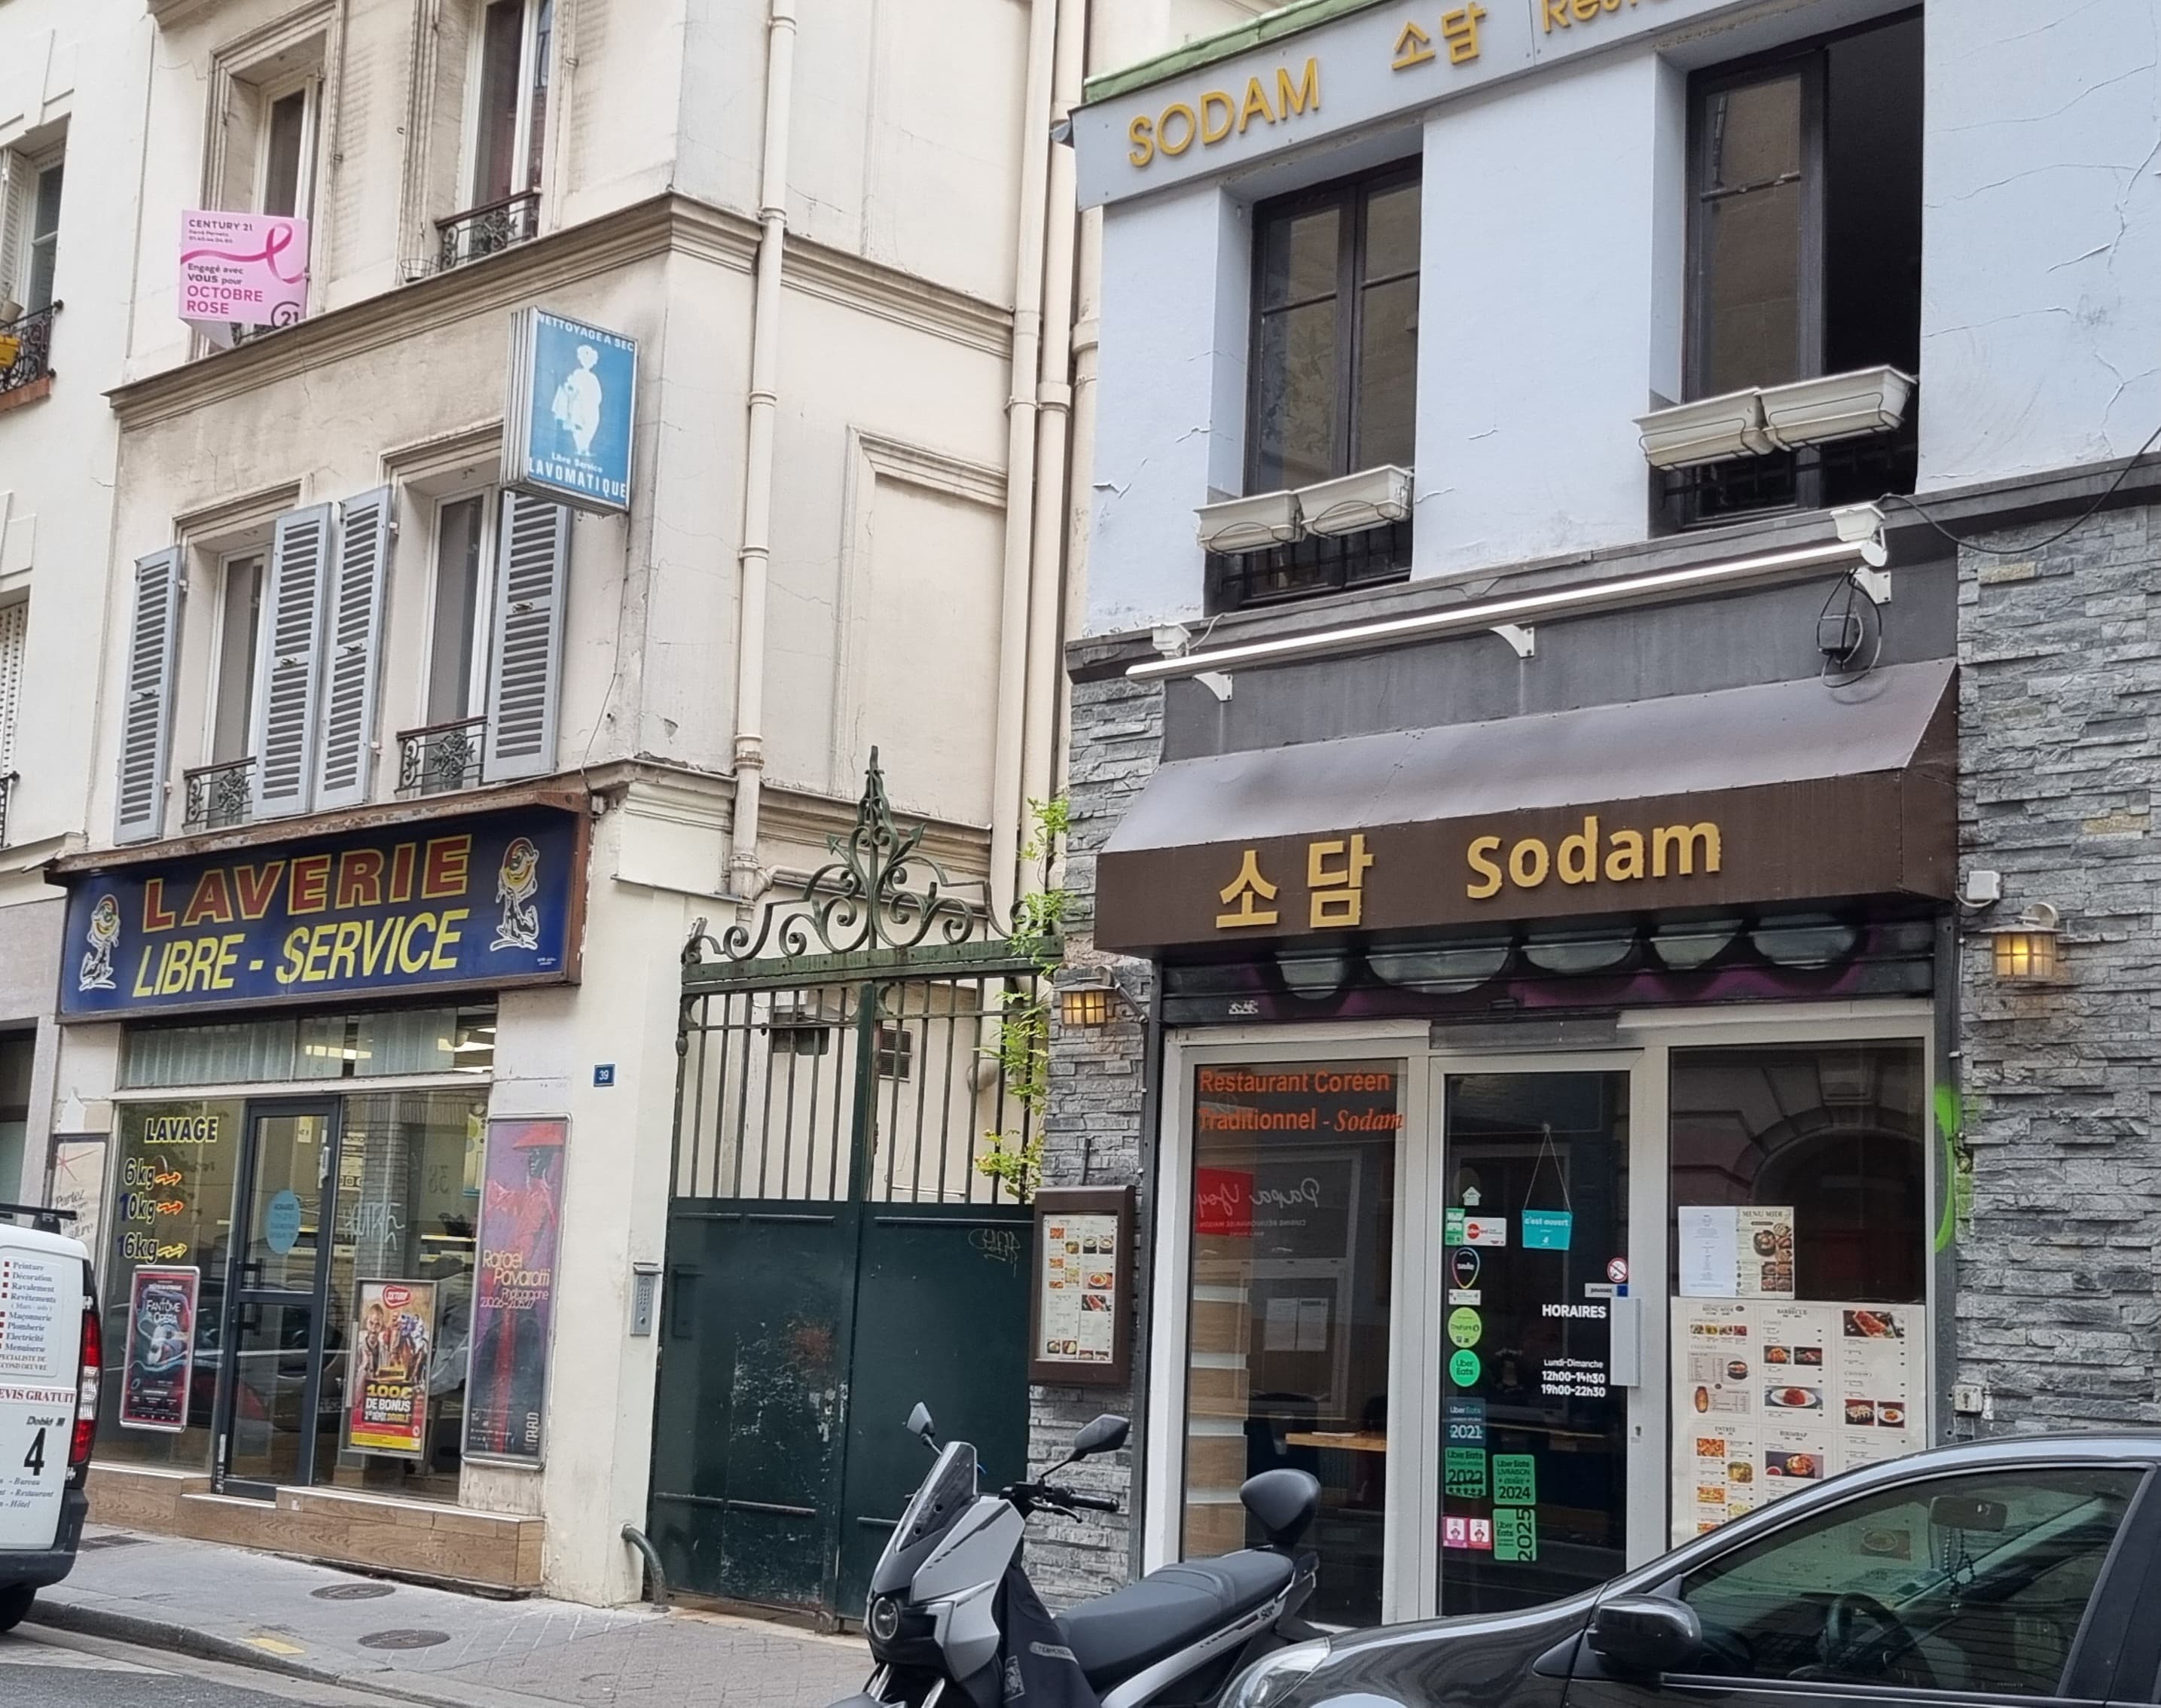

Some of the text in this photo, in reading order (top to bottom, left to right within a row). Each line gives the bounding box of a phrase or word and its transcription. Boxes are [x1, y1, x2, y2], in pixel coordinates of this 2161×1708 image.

[1392, 2, 1488, 70] 소담
[1127, 57, 1320, 167] SODAM
[189, 219, 253, 231] CENTURY 21
[188, 264, 220, 273] Engagé
[188, 285, 264, 303] OCTOBRE
[187, 300, 229, 314] ROSE
[280, 311, 299, 325] 21
[538, 314, 602, 342] NETTOYAGE
[615, 337, 635, 352] SEC
[529, 458, 626, 498] LAVOMATIQUE
[1467, 816, 1721, 899] Sodam
[142, 834, 472, 933] LAVERIE
[133, 934, 248, 997] LIBRE
[276, 908, 470, 984] SERVICE
[599, 1070, 609, 1081] 39
[1200, 1069, 1390, 1093] Restaurant Coréen
[1198, 1108, 1316, 1130] Traditionnel
[1334, 1109, 1405, 1131] Sodam
[145, 1116, 218, 1143] LAVAGE
[124, 1157, 156, 1191] 6kg
[119, 1192, 157, 1224] 10kg
[1544, 1218, 1569, 1227] ouvert
[118, 1232, 159, 1264] 16kg
[483, 1249, 523, 1268] Rafael
[12, 1282, 54, 1292] Ravalement
[1542, 1304, 1607, 1318] HORAIRES
[1544, 1359, 1604, 1368] Lundi-Dimanche
[1542, 1371, 1605, 1383] 12h00-14h30
[26, 1390, 75, 1403] GRATUIT
[1541, 1384, 1606, 1398] 19h00-22h30
[366, 1398, 411, 1412] DE BONUS
[1450, 1425, 1482, 1439] 2021
[24, 1427, 46, 1476] 4
[1447, 1469, 1483, 1484] 2022
[1499, 1486, 1531, 1499] 2024
[1516, 1508, 1533, 1561] 2025
